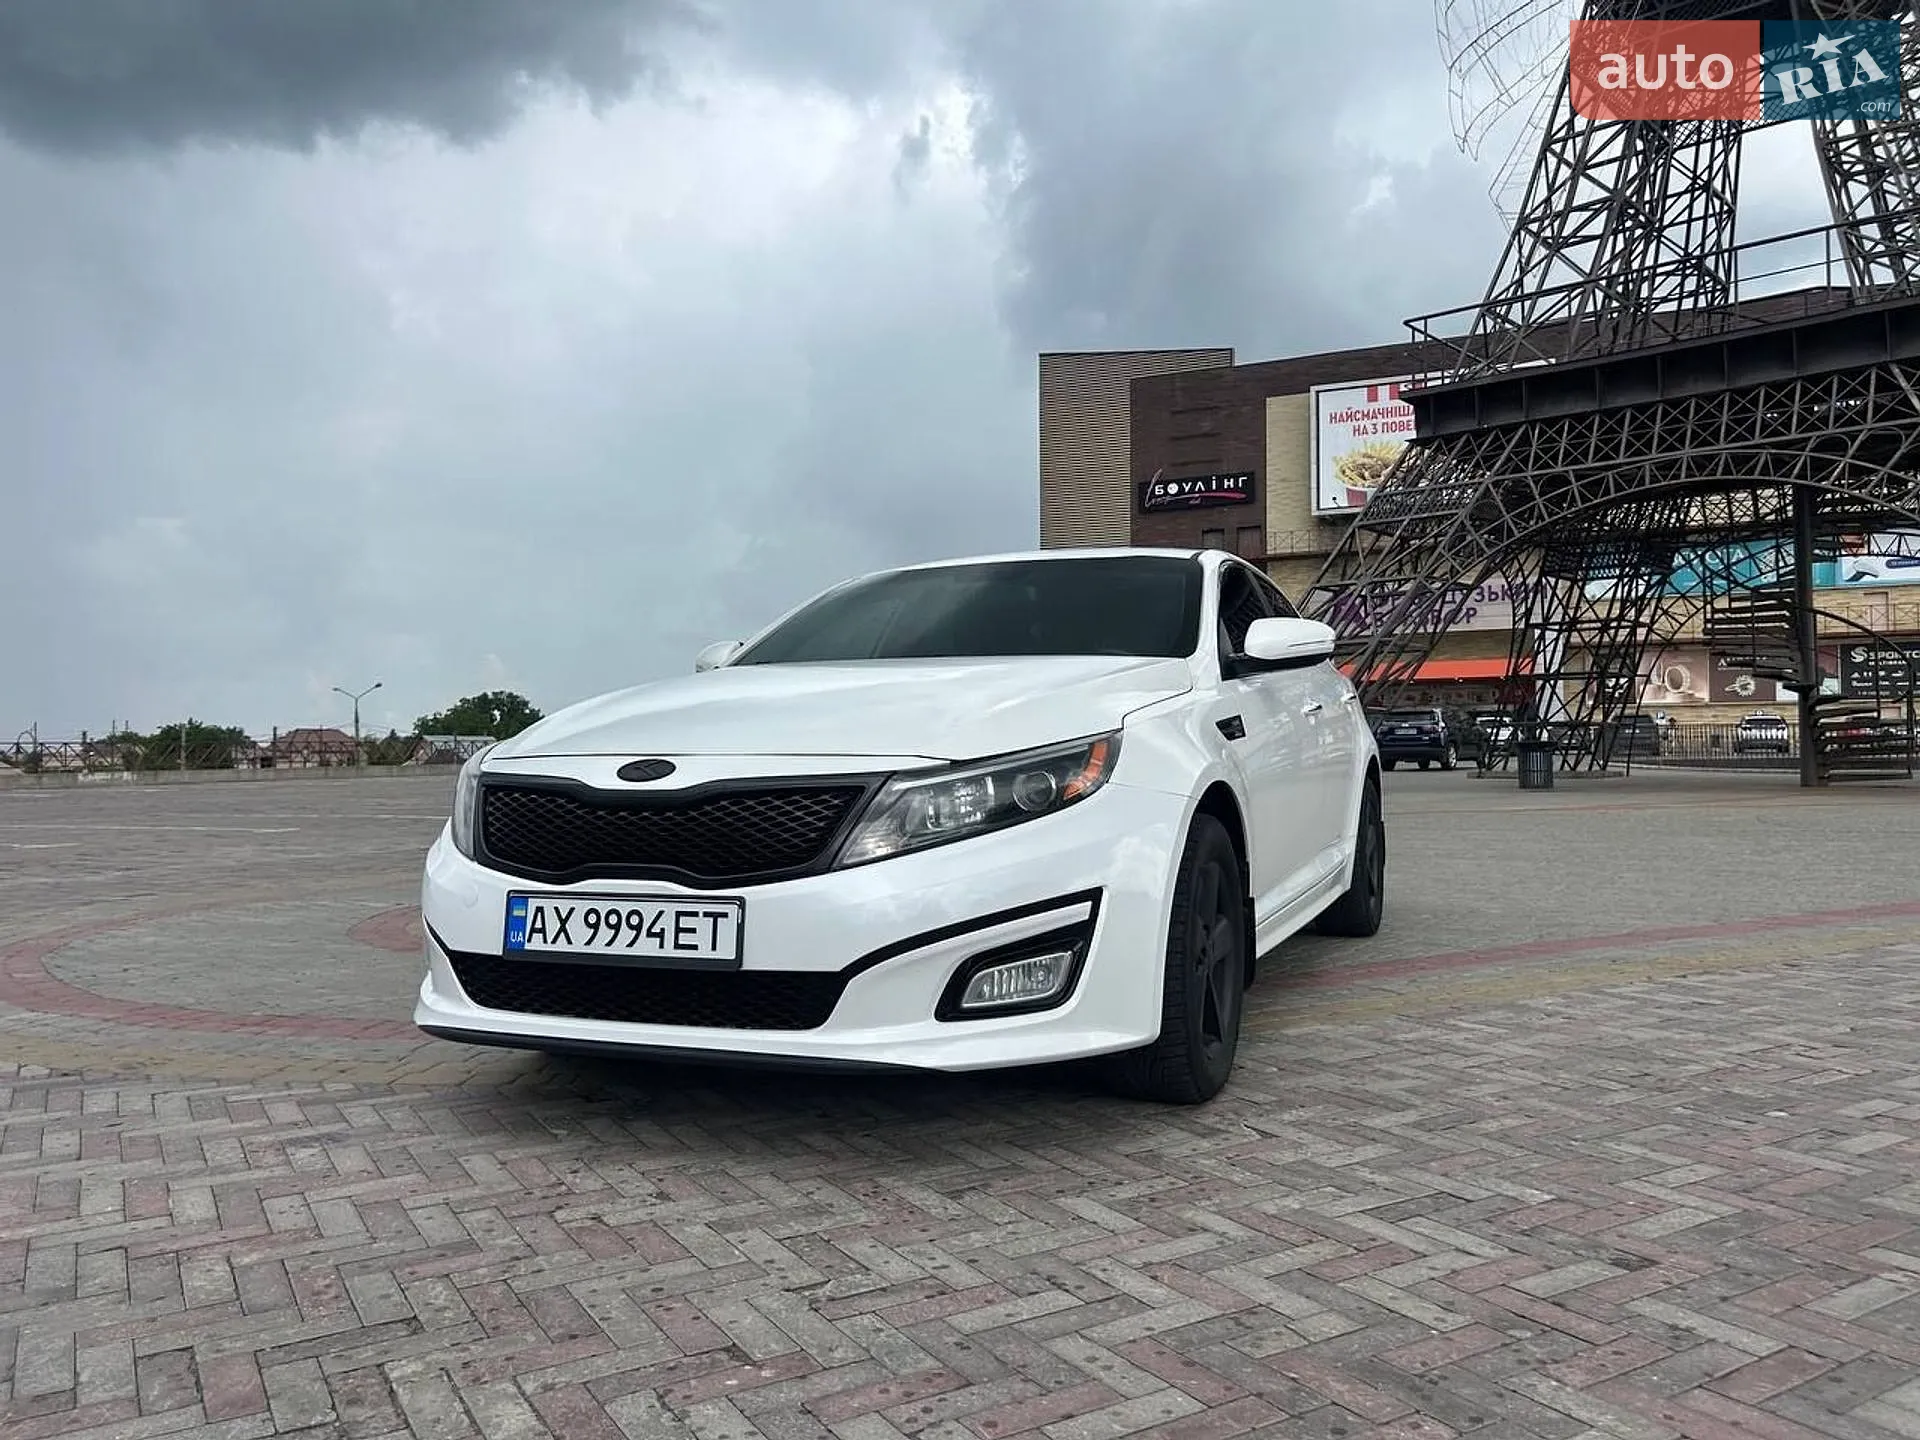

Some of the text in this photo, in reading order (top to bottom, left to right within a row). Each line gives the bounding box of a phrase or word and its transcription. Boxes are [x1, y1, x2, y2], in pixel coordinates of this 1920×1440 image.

[1353, 425, 1368, 436] НА
[527, 906, 729, 951] AX 9994 ET
[510, 931, 524, 943] UA
